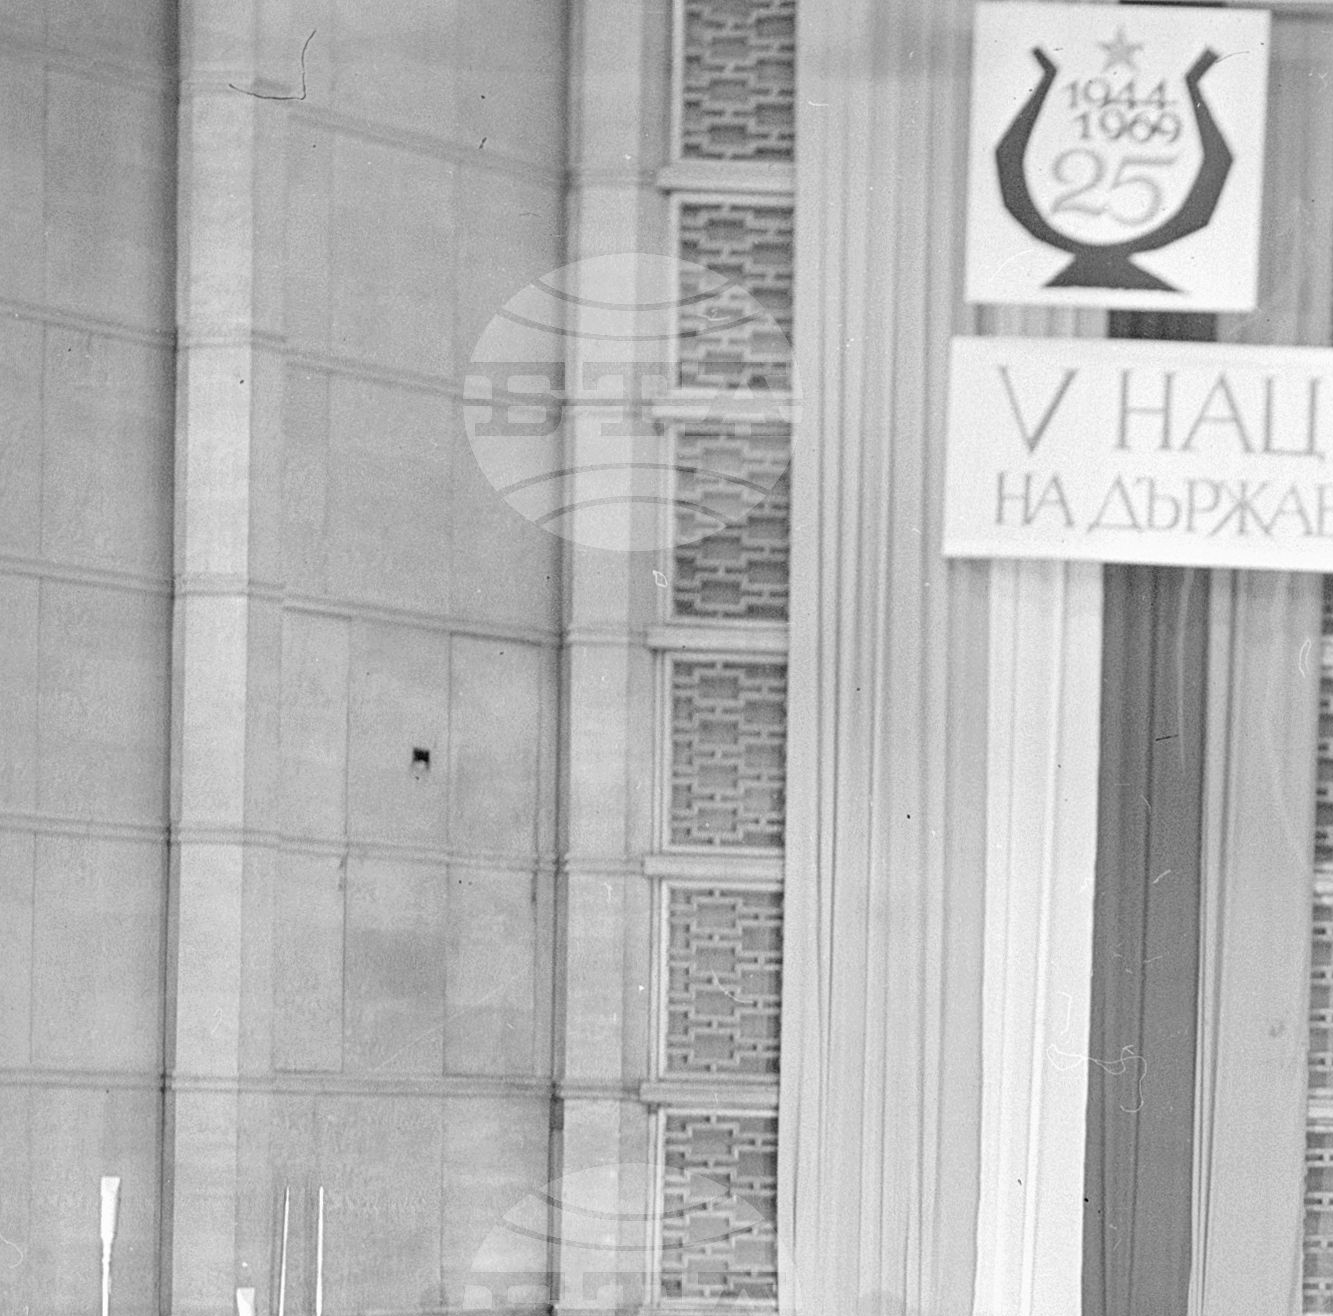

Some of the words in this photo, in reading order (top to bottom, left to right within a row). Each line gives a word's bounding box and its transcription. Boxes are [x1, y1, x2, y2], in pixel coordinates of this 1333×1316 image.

[1064, 77, 1176, 110] 1944
[1073, 105, 1182, 143] 1969
[1051, 149, 1179, 226] 25
[997, 364, 1080, 455] V
[994, 471, 1076, 528] НА
